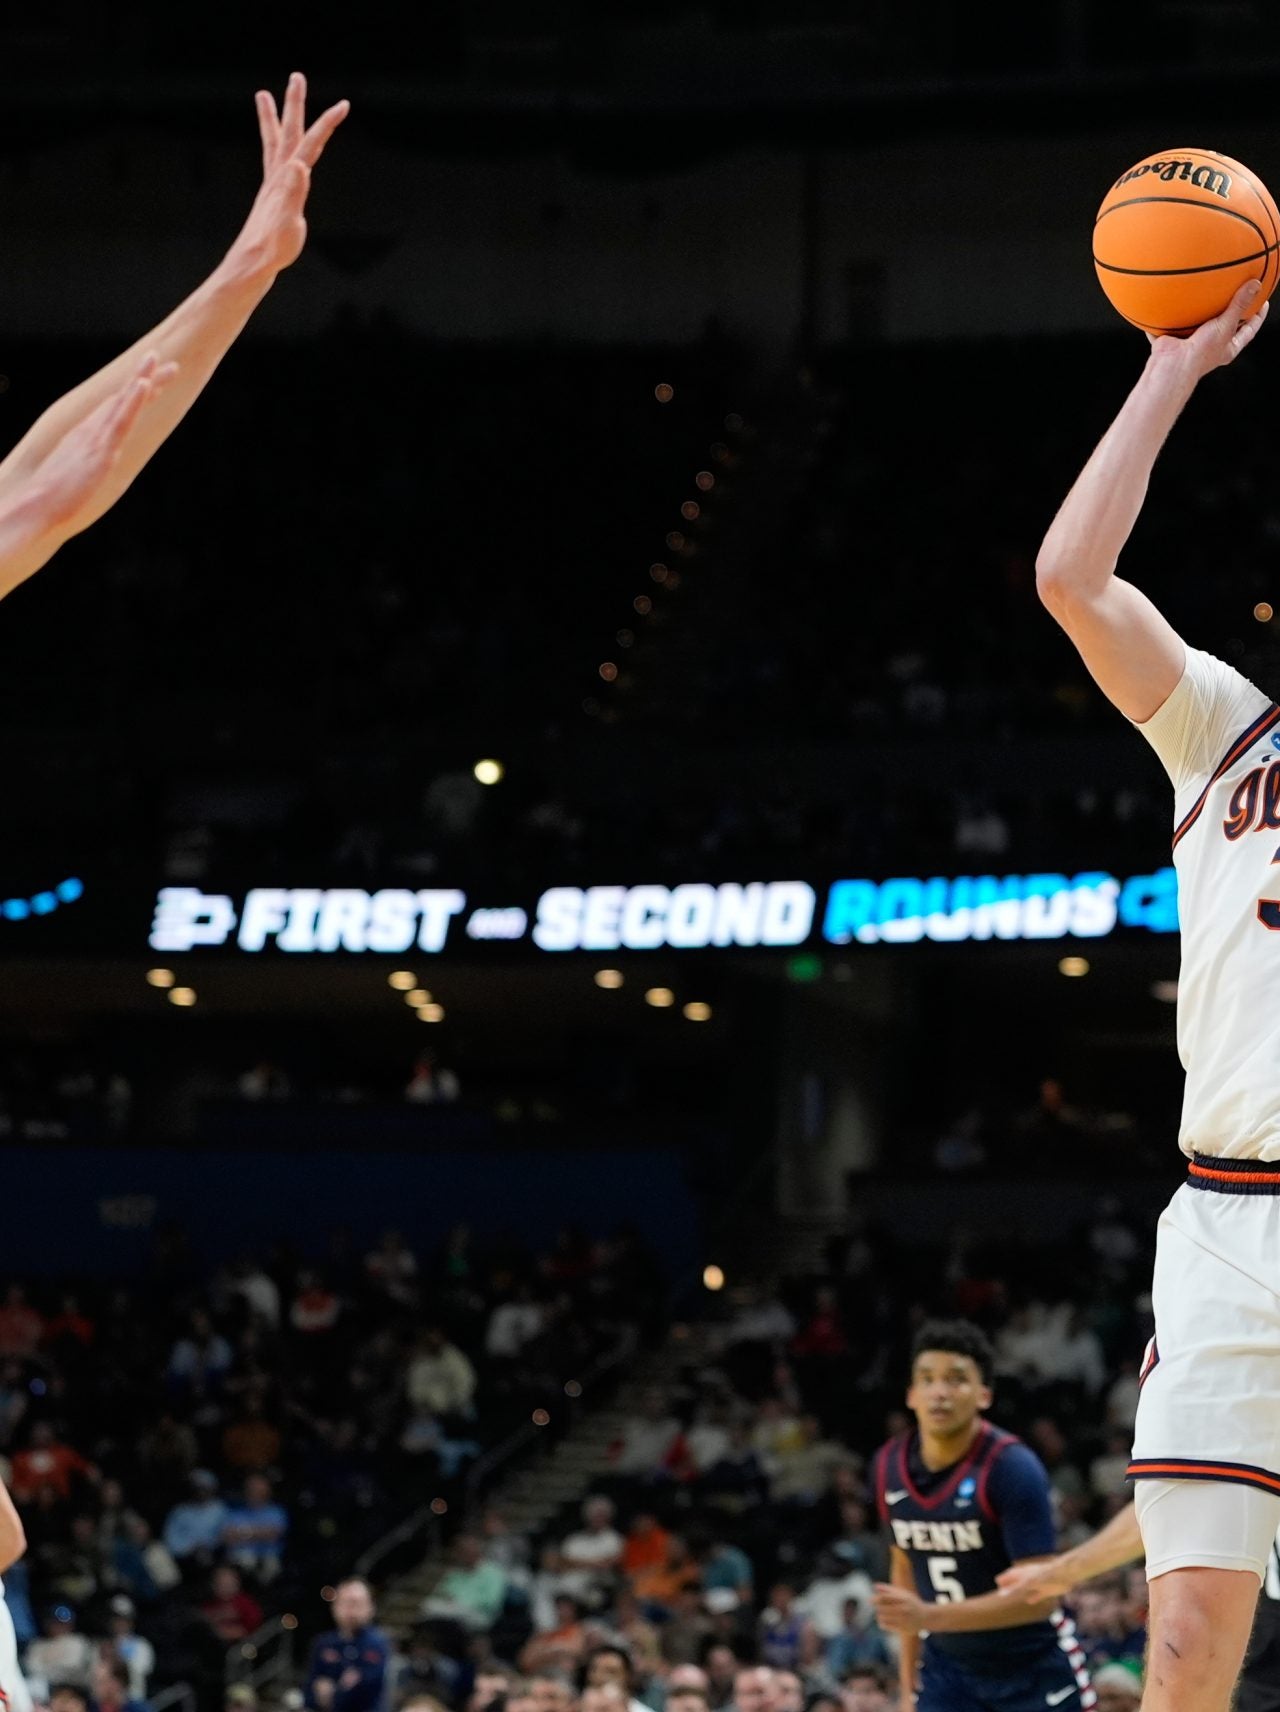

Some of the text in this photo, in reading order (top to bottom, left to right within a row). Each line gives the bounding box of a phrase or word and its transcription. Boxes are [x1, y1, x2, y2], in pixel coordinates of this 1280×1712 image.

[1115, 160, 1233, 200] Wilson
[238, 888, 466, 953] FIRST
[533, 880, 815, 952] SECOND
[823, 870, 1121, 944] ROUNDS
[891, 1520, 984, 1552] PENN
[927, 1557, 966, 1604] 5
